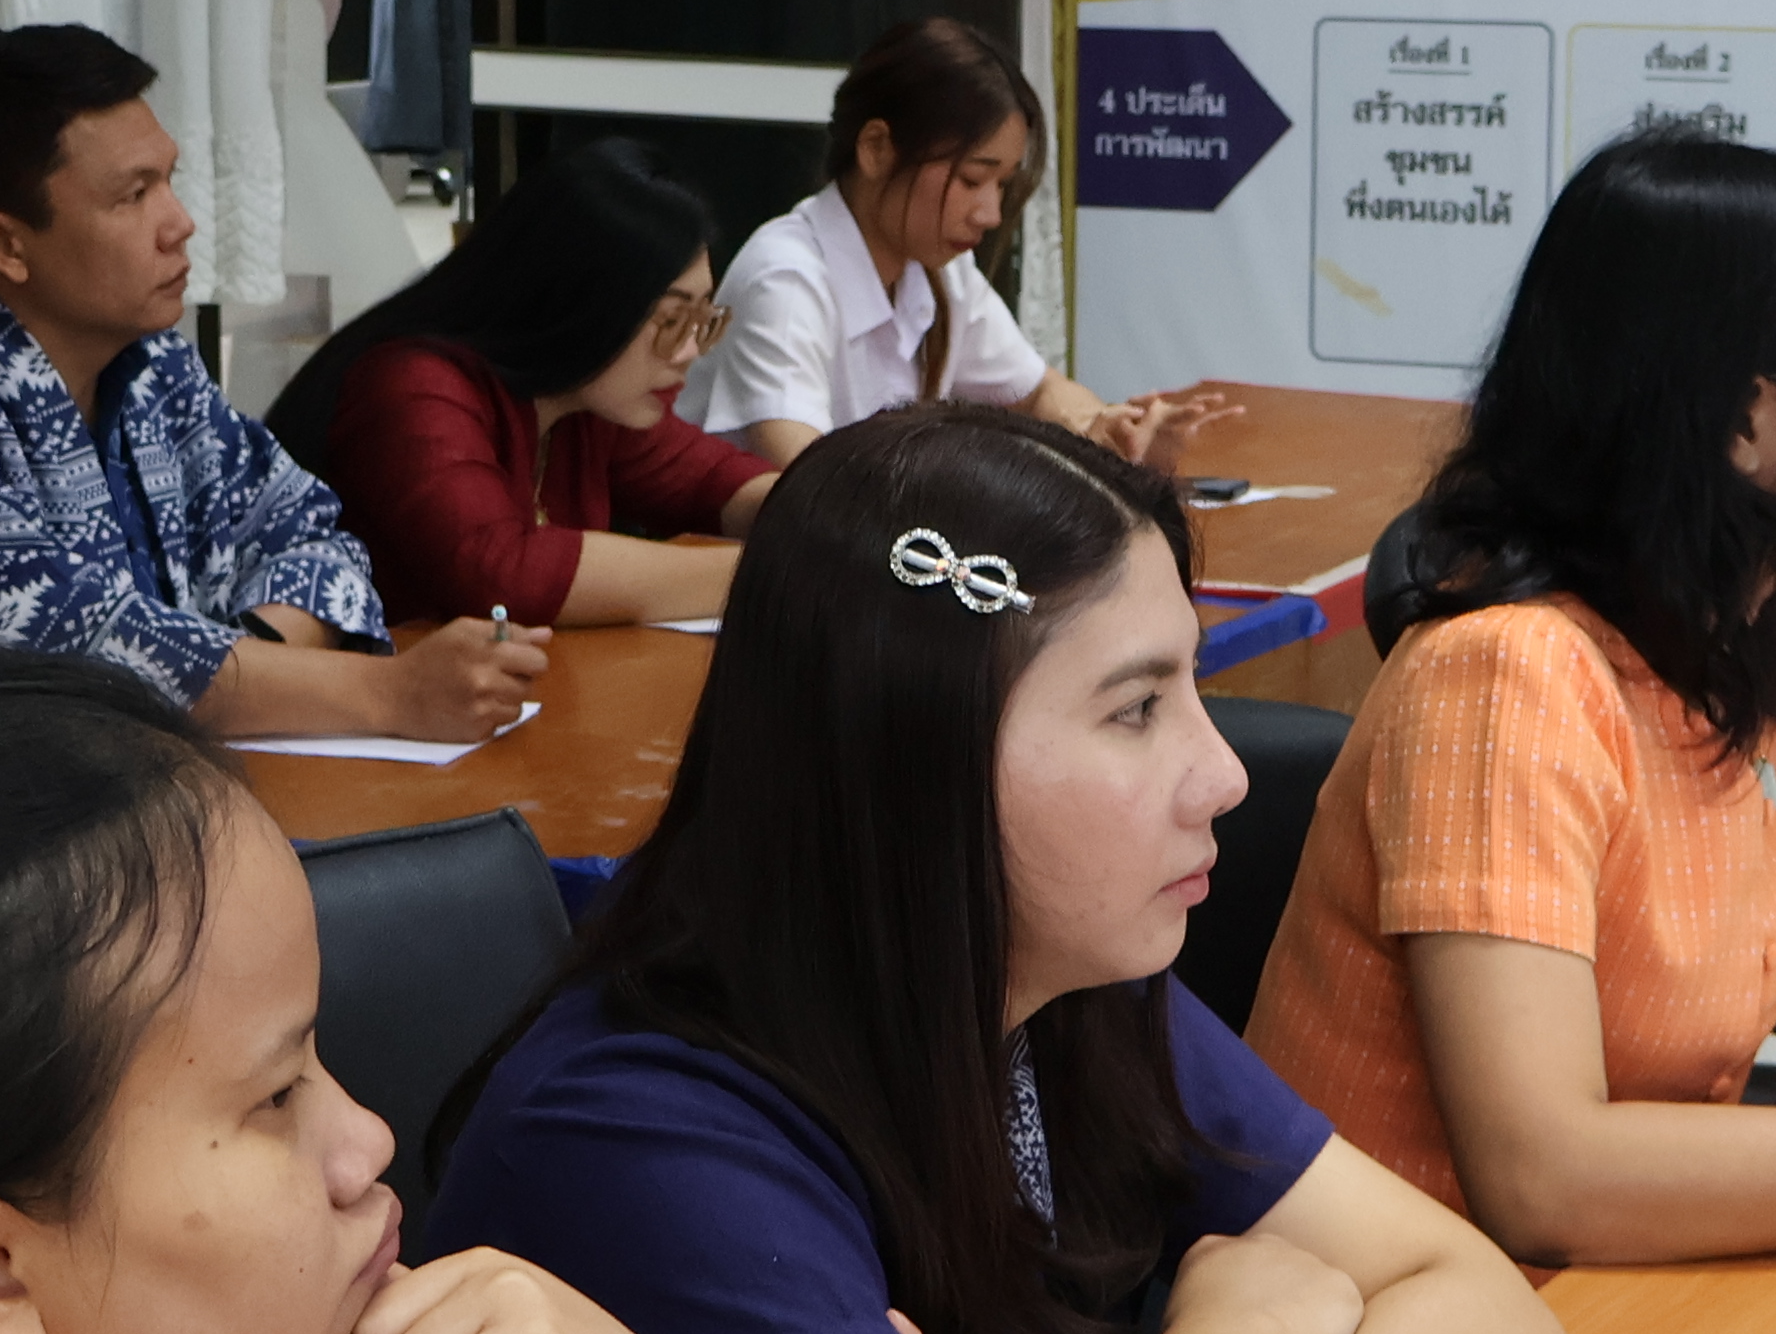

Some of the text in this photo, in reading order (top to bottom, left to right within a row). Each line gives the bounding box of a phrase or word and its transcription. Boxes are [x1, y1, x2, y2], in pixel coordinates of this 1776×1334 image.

[1719, 52, 1730, 72] 2
[1098, 82, 1226, 118] 4 ประเด็น
[1352, 89, 1507, 128] สร้างสรรค์
[1094, 126, 1229, 161] การพัฒนา
[1385, 148, 1473, 186] ชุมชน
[1343, 178, 1512, 226] พึ่งตนเองได้
